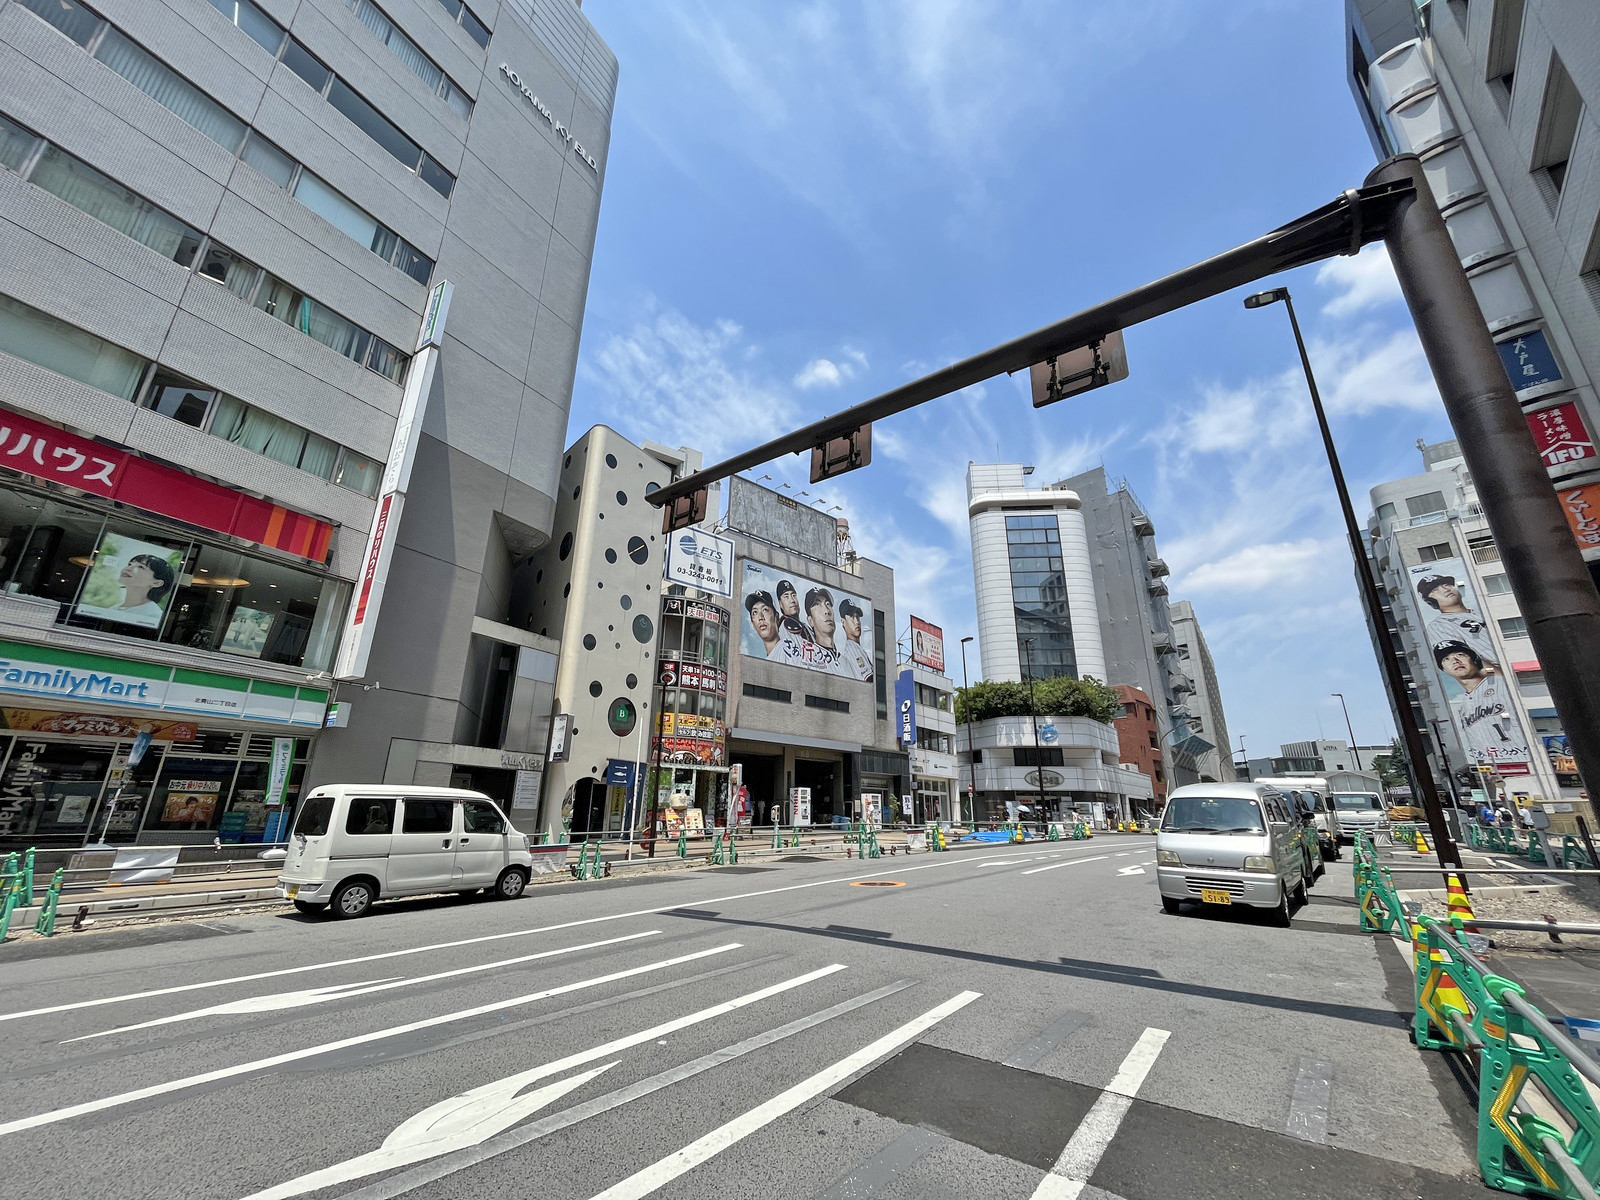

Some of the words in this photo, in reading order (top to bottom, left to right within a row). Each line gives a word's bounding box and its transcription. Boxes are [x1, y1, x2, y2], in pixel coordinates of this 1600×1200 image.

[499, 62, 552, 125] AOYAMA
[1513, 338, 1540, 377] 大戸屋
[1537, 412, 1558, 444] ラーメン
[1547, 446, 1585, 465] IFU
[366, 511, 387, 580] 三井のリハウス
[903, 713, 912, 742] 日酒販
